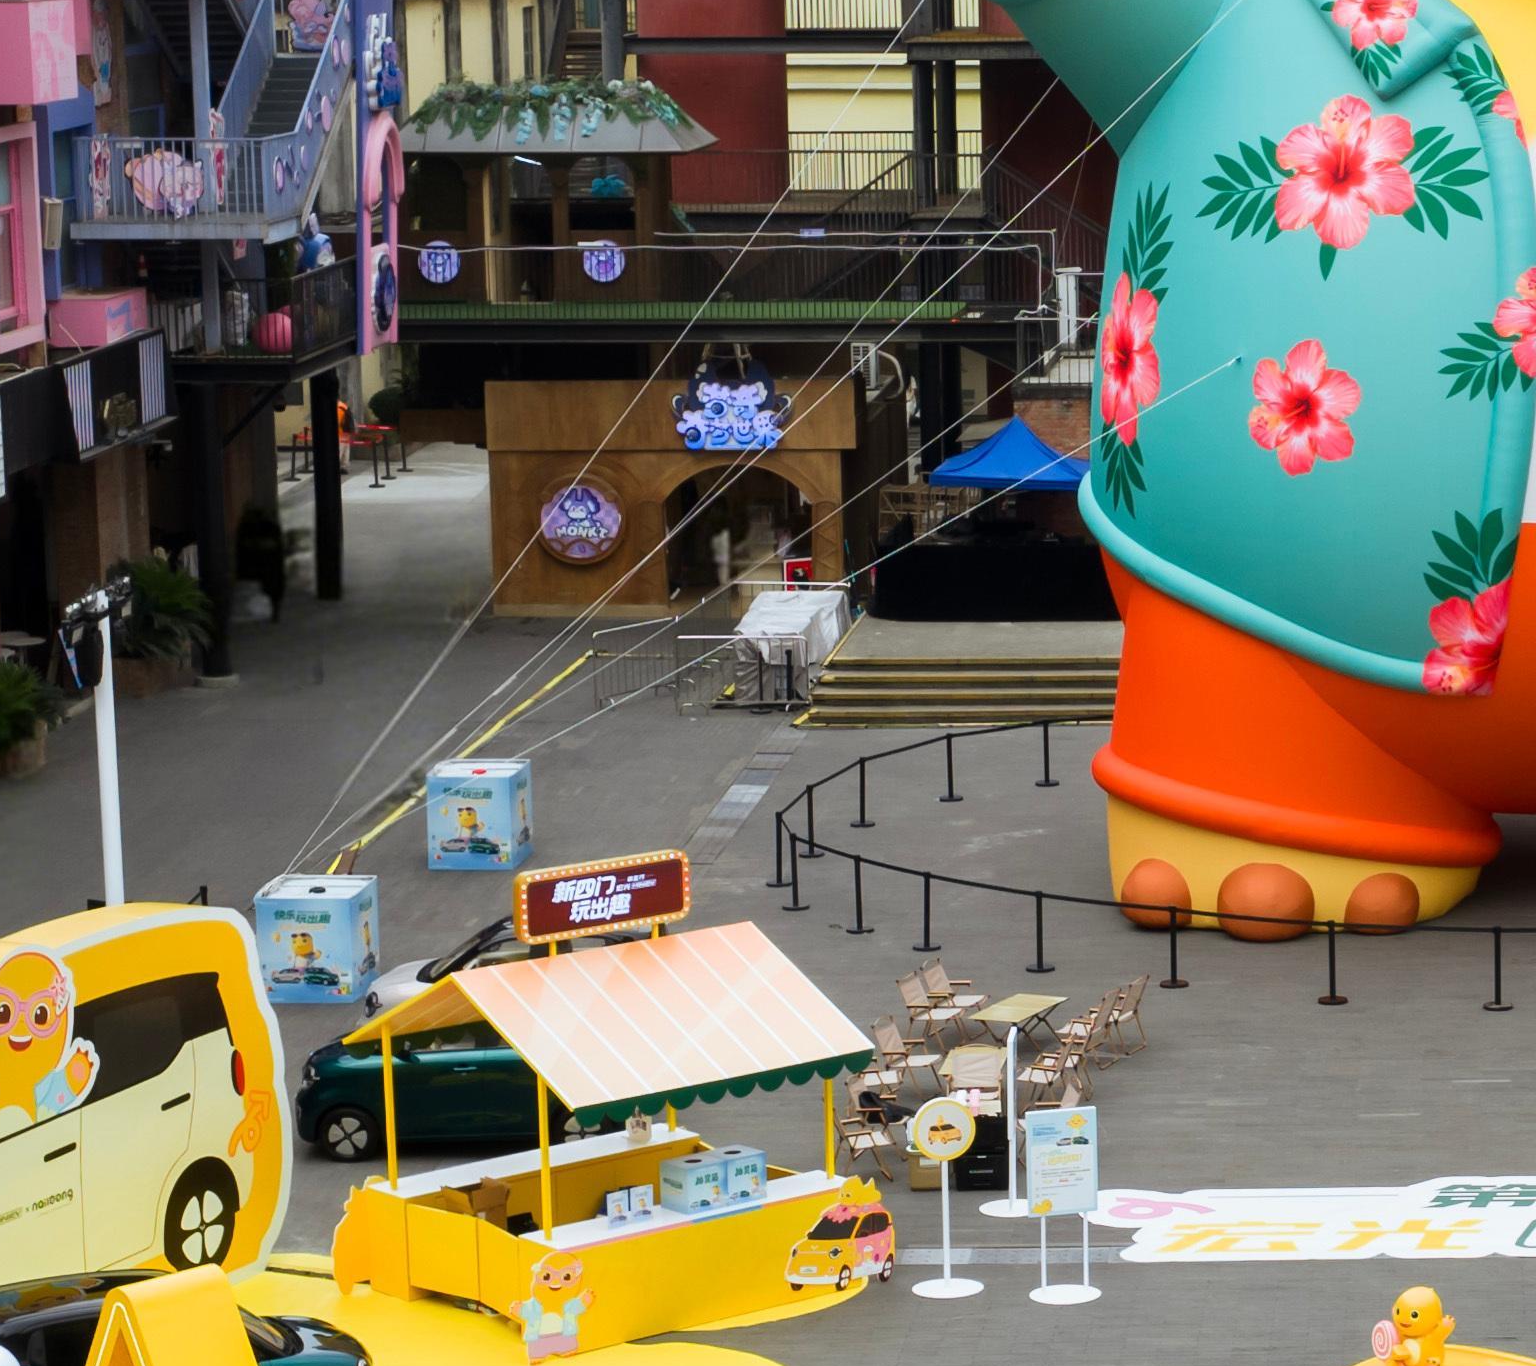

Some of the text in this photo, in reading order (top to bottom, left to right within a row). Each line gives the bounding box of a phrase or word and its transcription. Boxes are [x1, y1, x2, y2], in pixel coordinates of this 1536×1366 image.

[552, 875, 616, 904] 新四门
[569, 892, 631, 923] 玩出趣
[1161, 1217, 1487, 1253] 宏光
